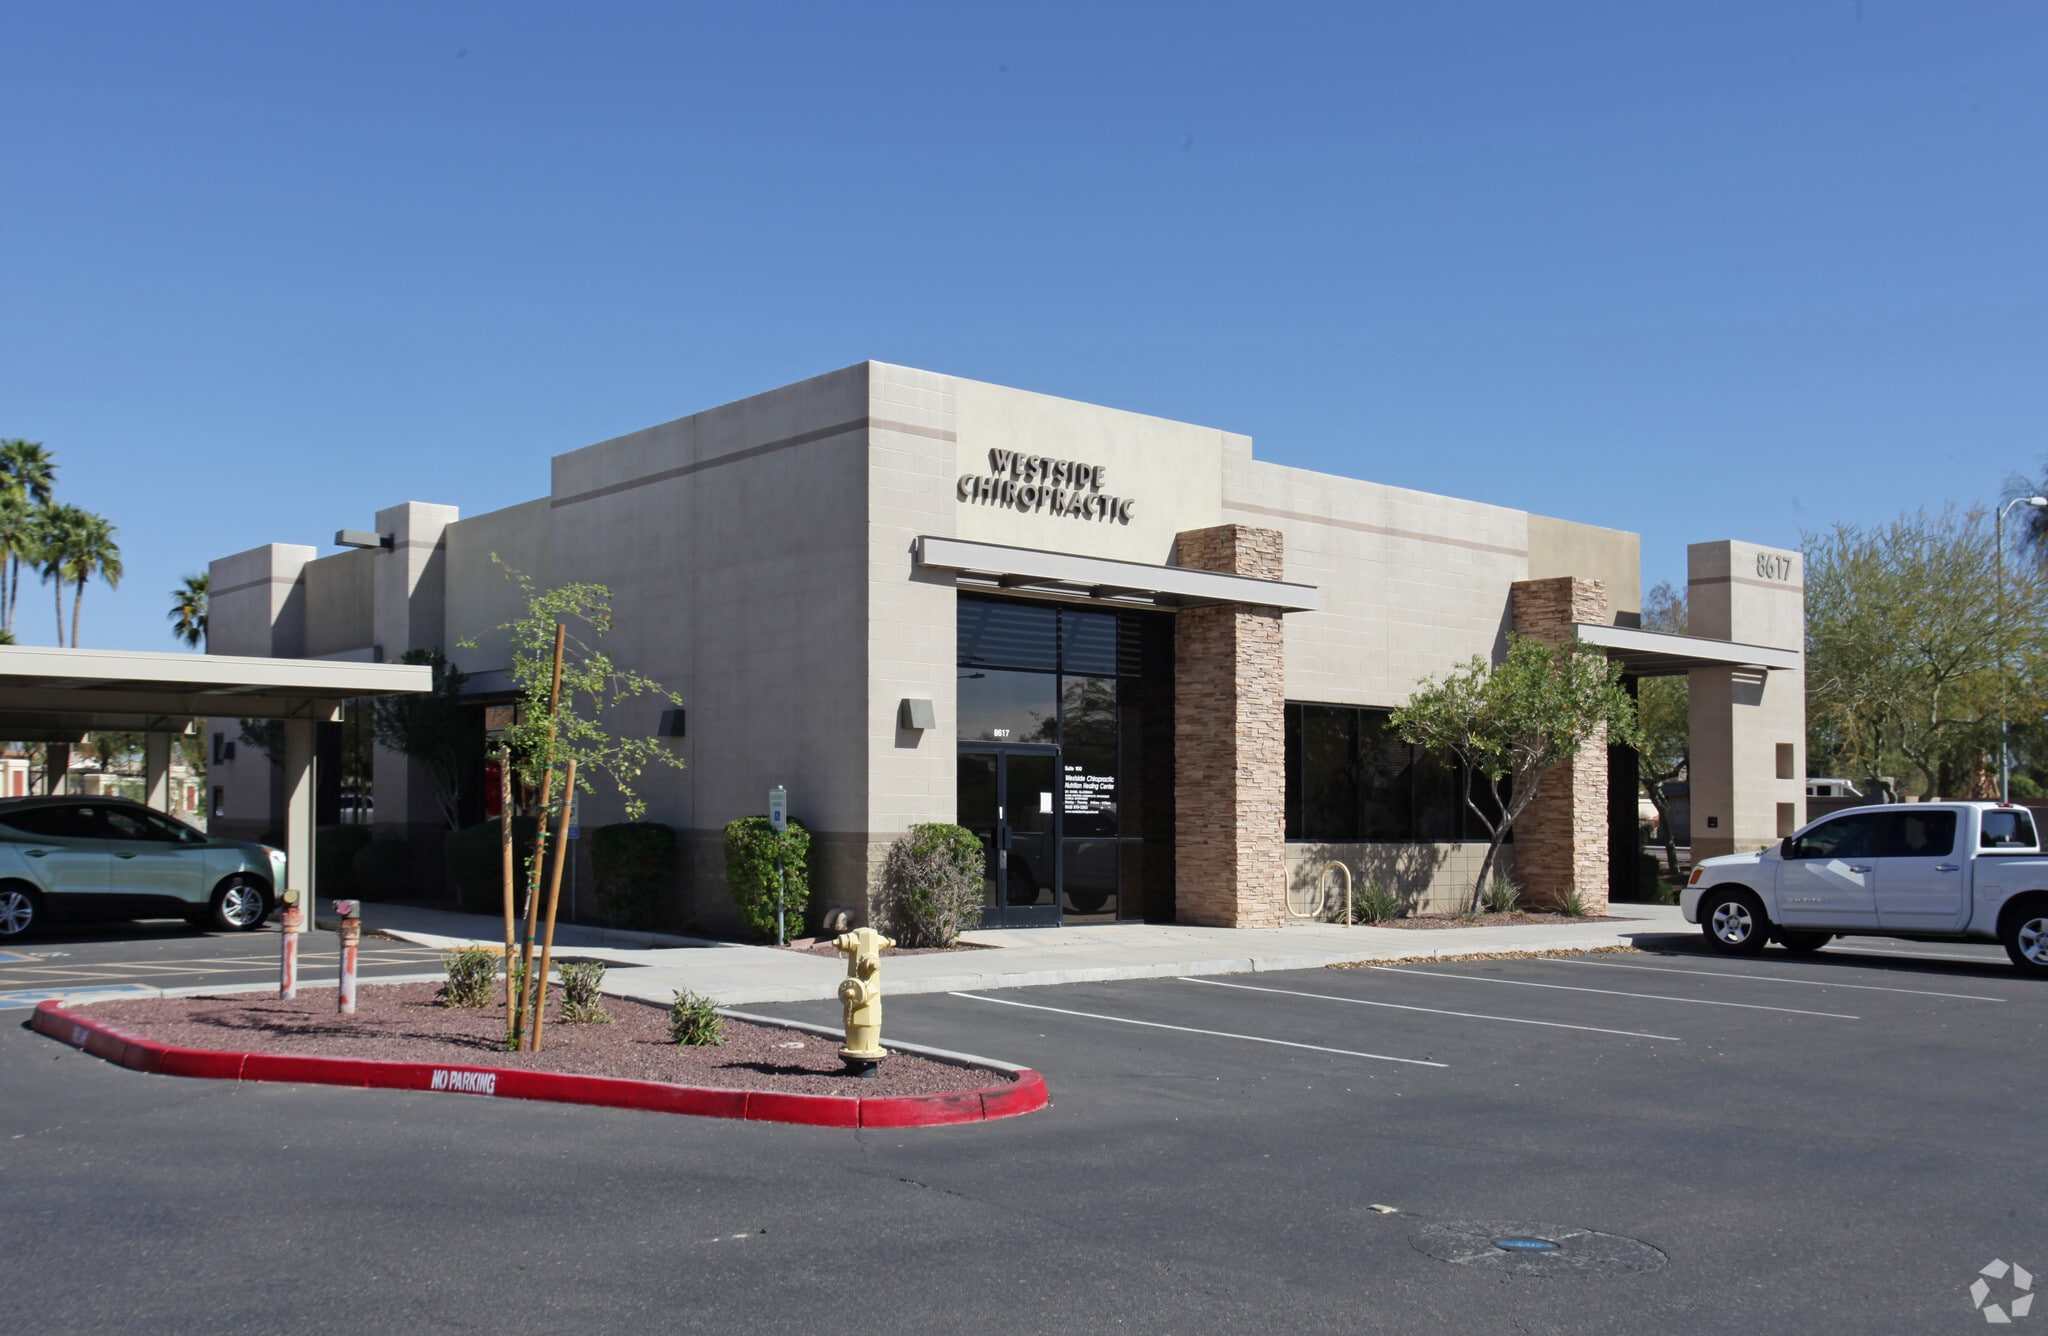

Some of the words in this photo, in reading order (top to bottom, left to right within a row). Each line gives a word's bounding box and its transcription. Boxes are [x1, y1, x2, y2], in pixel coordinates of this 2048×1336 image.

[990, 448, 1106, 490] WESTSIDE
[957, 473, 1136, 523] CHIROPRACTIC
[1756, 551, 1792, 581] 8617
[993, 728, 1010, 737] 8617
[1086, 775, 1115, 783] Chiropractic
[431, 1069, 449, 1090] NO
[448, 1070, 496, 1094] PARKING
